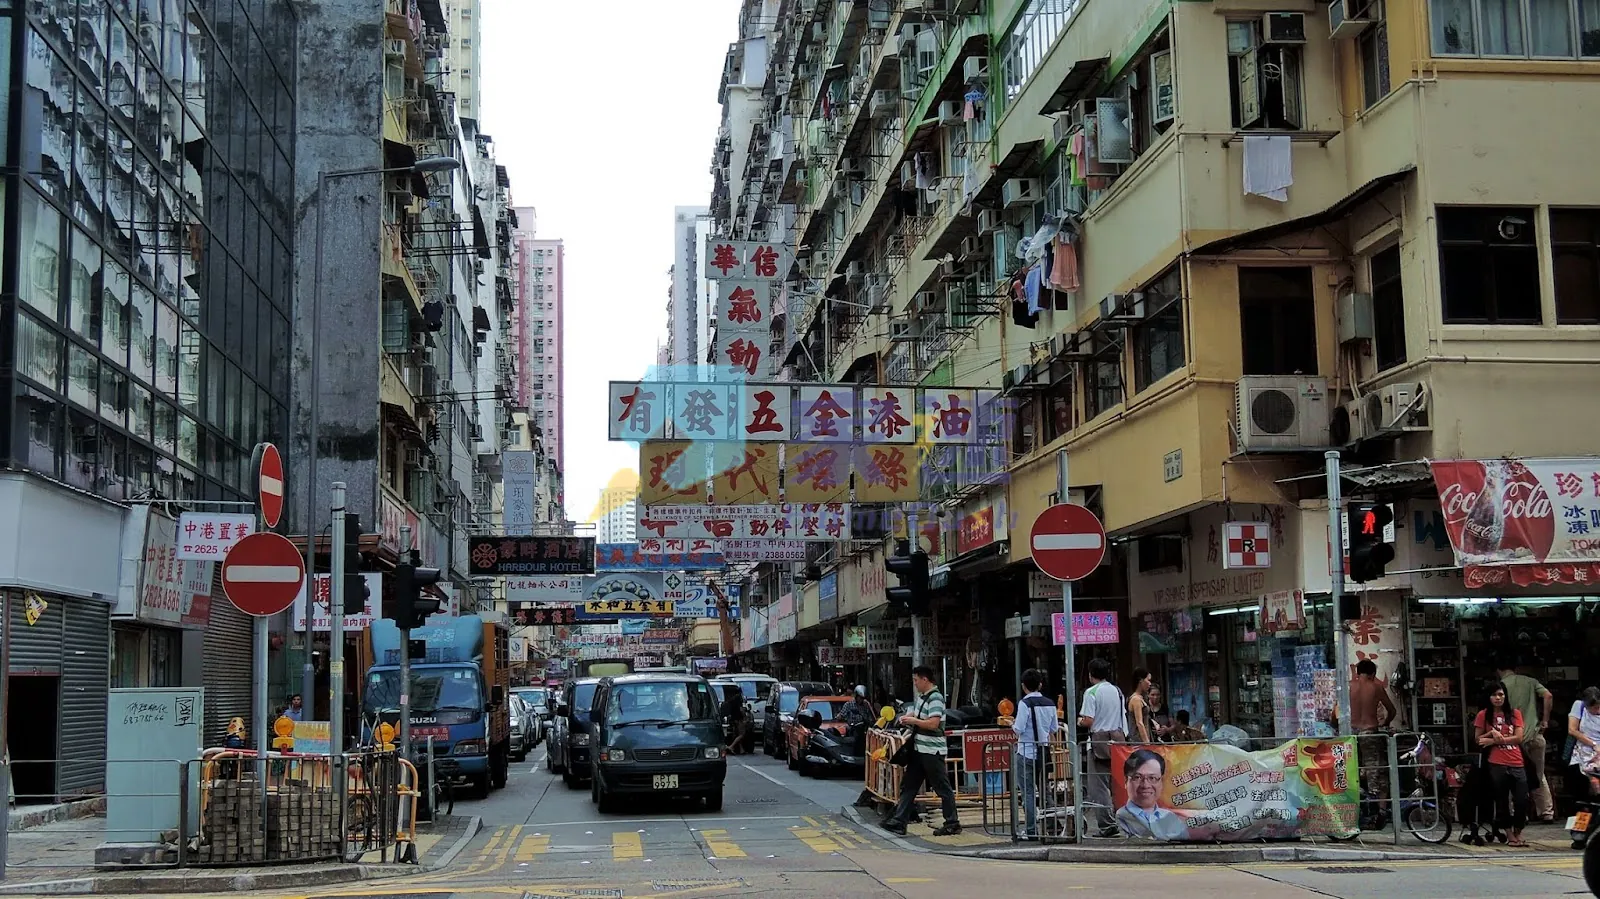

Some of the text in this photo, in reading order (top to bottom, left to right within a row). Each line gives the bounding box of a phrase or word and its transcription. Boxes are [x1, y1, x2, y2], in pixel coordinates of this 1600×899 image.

[711, 244, 780, 277] 華信
[649, 446, 910, 496] 現代螺絲
[184, 521, 249, 541] 中港置業
[195, 544, 218, 554] 2625
[1569, 538, 1600, 550] TOK
[498, 562, 585, 572] HARBOUR HOTEL
[664, 591, 683, 599] FAG
[1187, 576, 1233, 601] DISPENSARY
[1234, 571, 1266, 596] LIMITED
[409, 716, 437, 724] SUZU
[1171, 761, 1213, 788] 社區投訴
[654, 781, 677, 789] 9973
[1171, 781, 1215, 807] 勞工法例
[1205, 785, 1249, 811] 個案輔導
